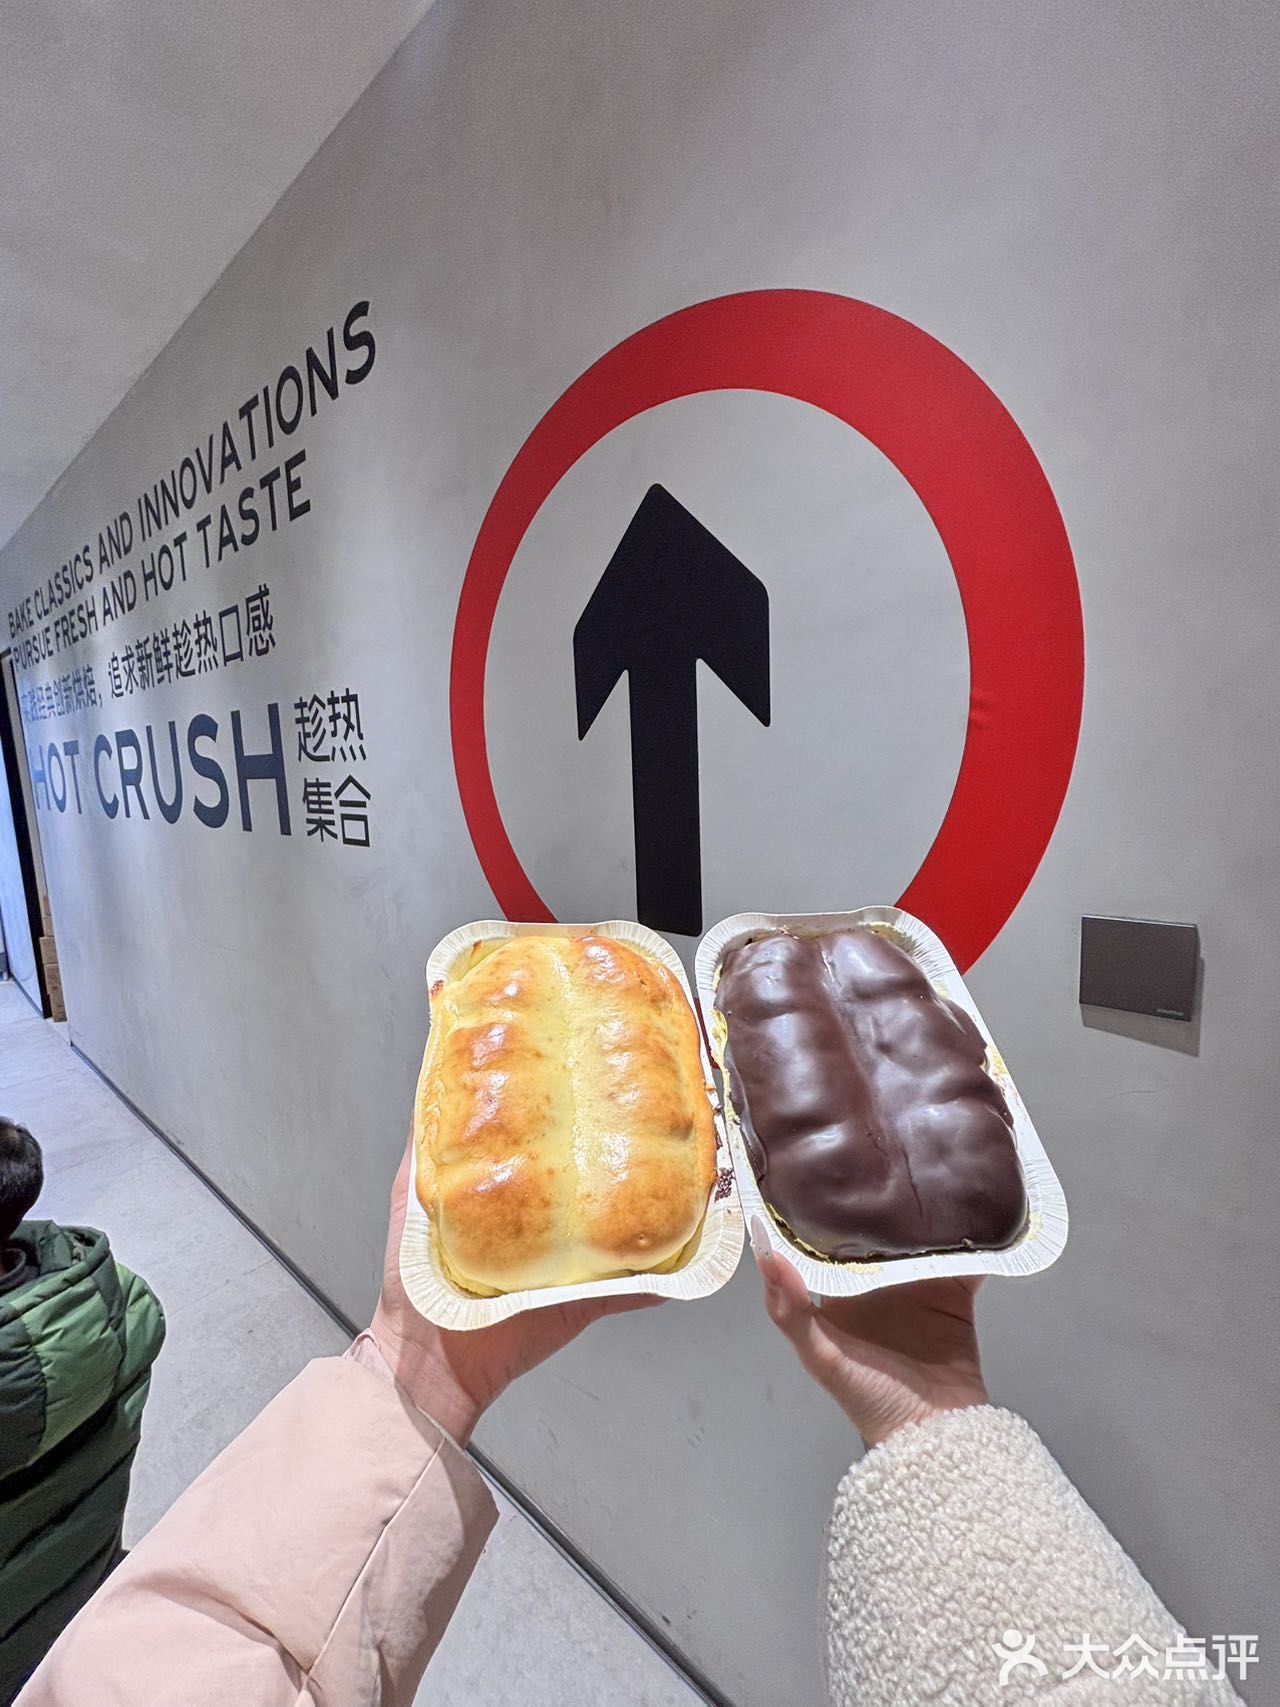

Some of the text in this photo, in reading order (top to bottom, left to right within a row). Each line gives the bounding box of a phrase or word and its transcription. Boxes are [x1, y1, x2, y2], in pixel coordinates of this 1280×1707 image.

[7, 300, 376, 639] BAKE CLASSICS AND INNOVATIONS
[13, 448, 311, 672] PURSUE FRESH AND HOT TASTE
[28, 702, 292, 836] HOT CRUSH
[294, 687, 367, 763] 趁热
[302, 774, 371, 848] 集合
